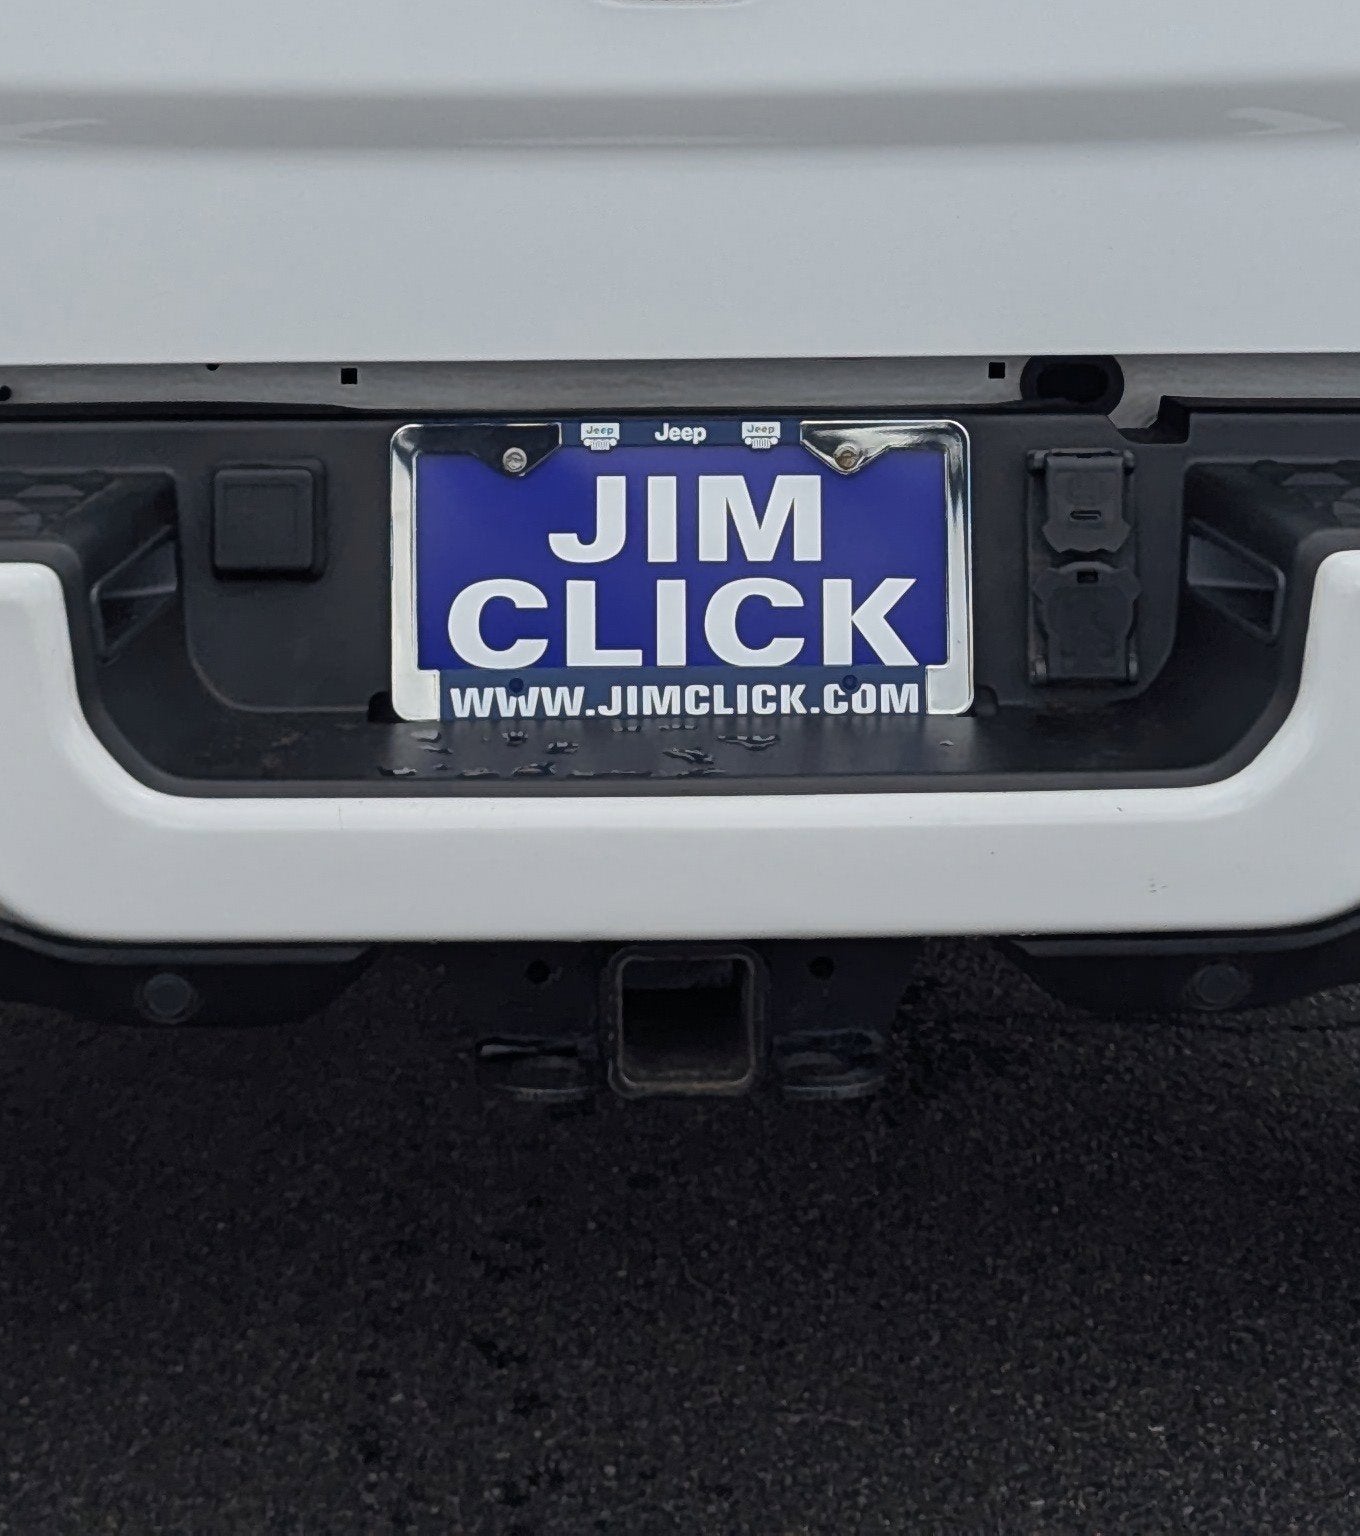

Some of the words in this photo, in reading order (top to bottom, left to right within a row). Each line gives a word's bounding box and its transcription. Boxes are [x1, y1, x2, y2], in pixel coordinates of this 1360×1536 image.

[586, 425, 614, 435] Jeep
[655, 422, 707, 444] Jeep
[746, 424, 775, 434] Jeep
[548, 475, 821, 563] JIM
[447, 577, 919, 669] CLICK
[449, 683, 919, 718] WWW.JIMCLICK.COM
